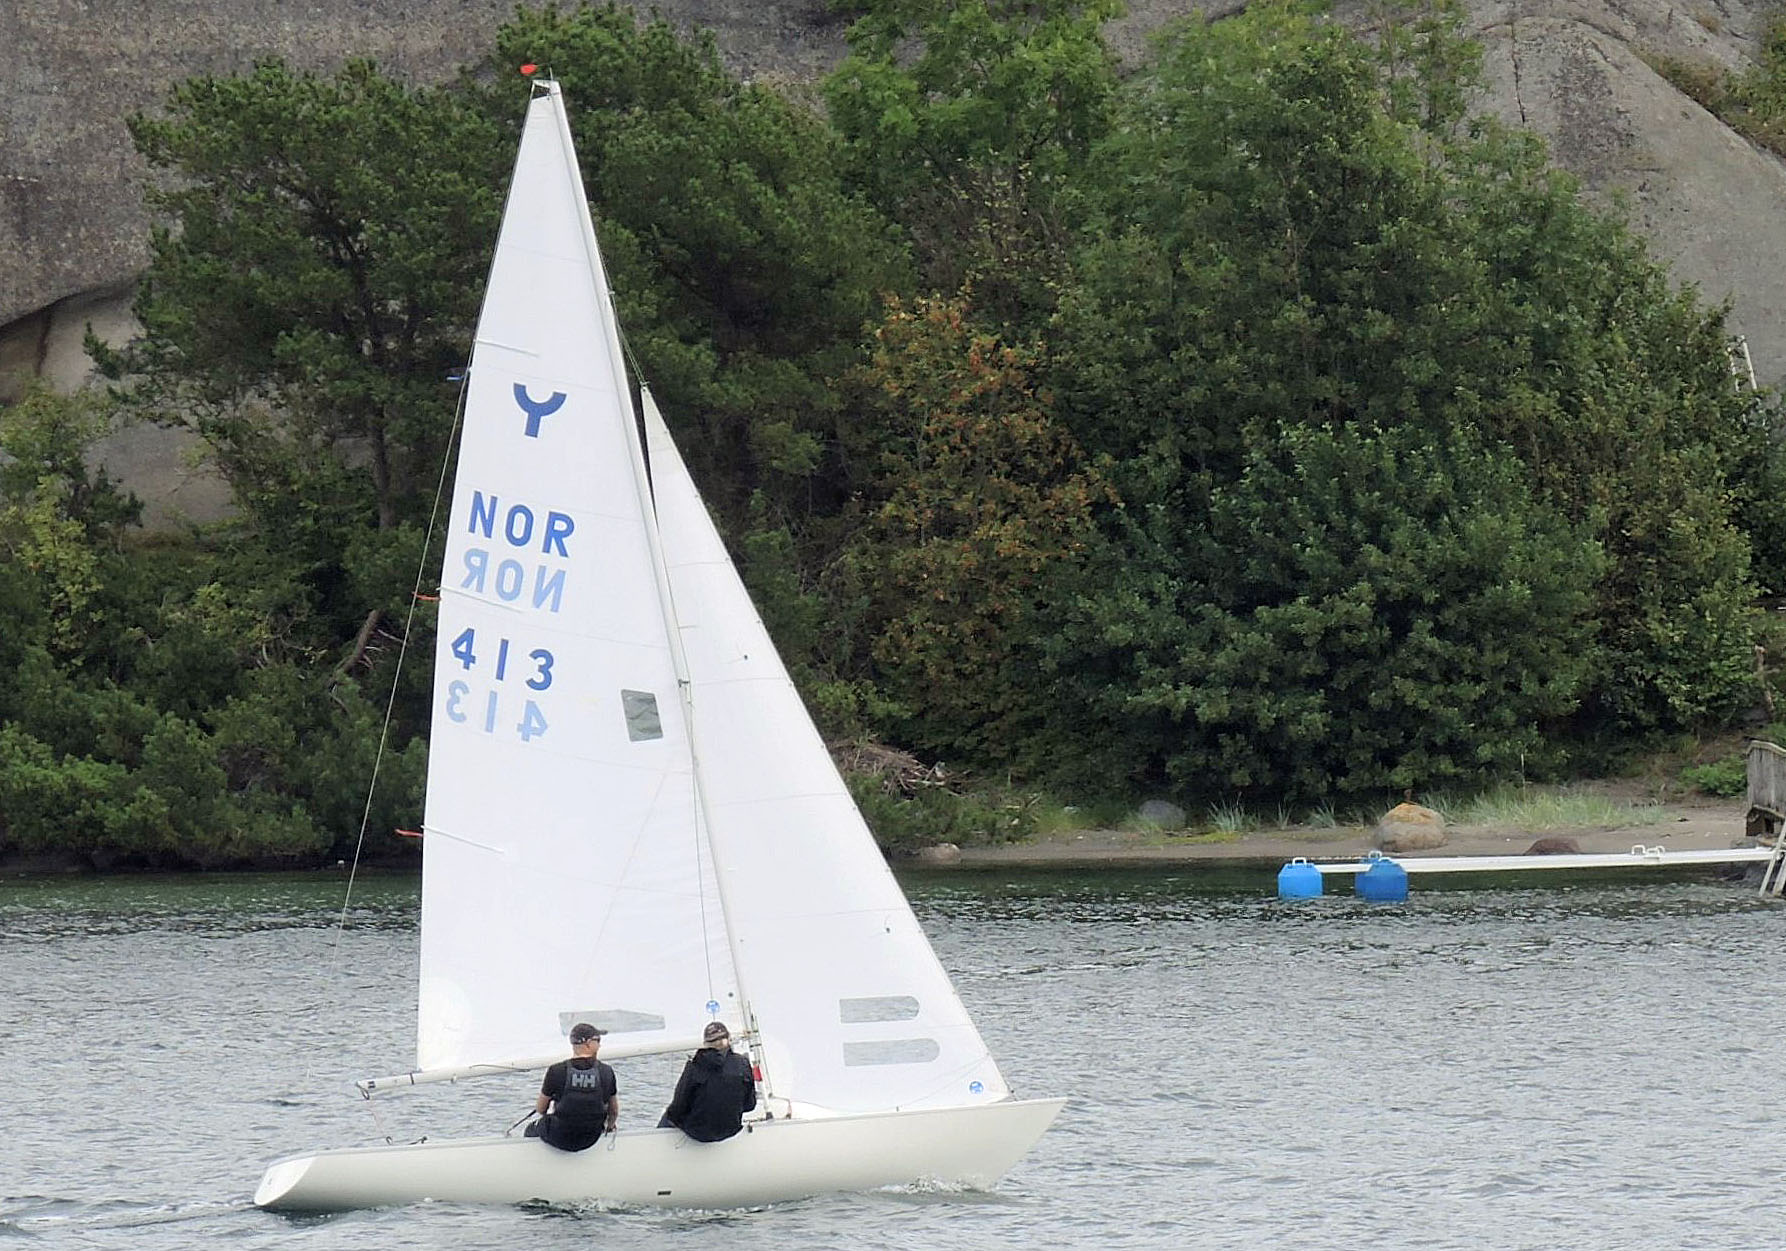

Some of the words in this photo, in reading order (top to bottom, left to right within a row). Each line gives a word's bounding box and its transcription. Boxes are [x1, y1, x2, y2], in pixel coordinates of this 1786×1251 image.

[468, 490, 575, 558] NOR
[451, 627, 554, 691] 413
[573, 1073, 596, 1088] HH
